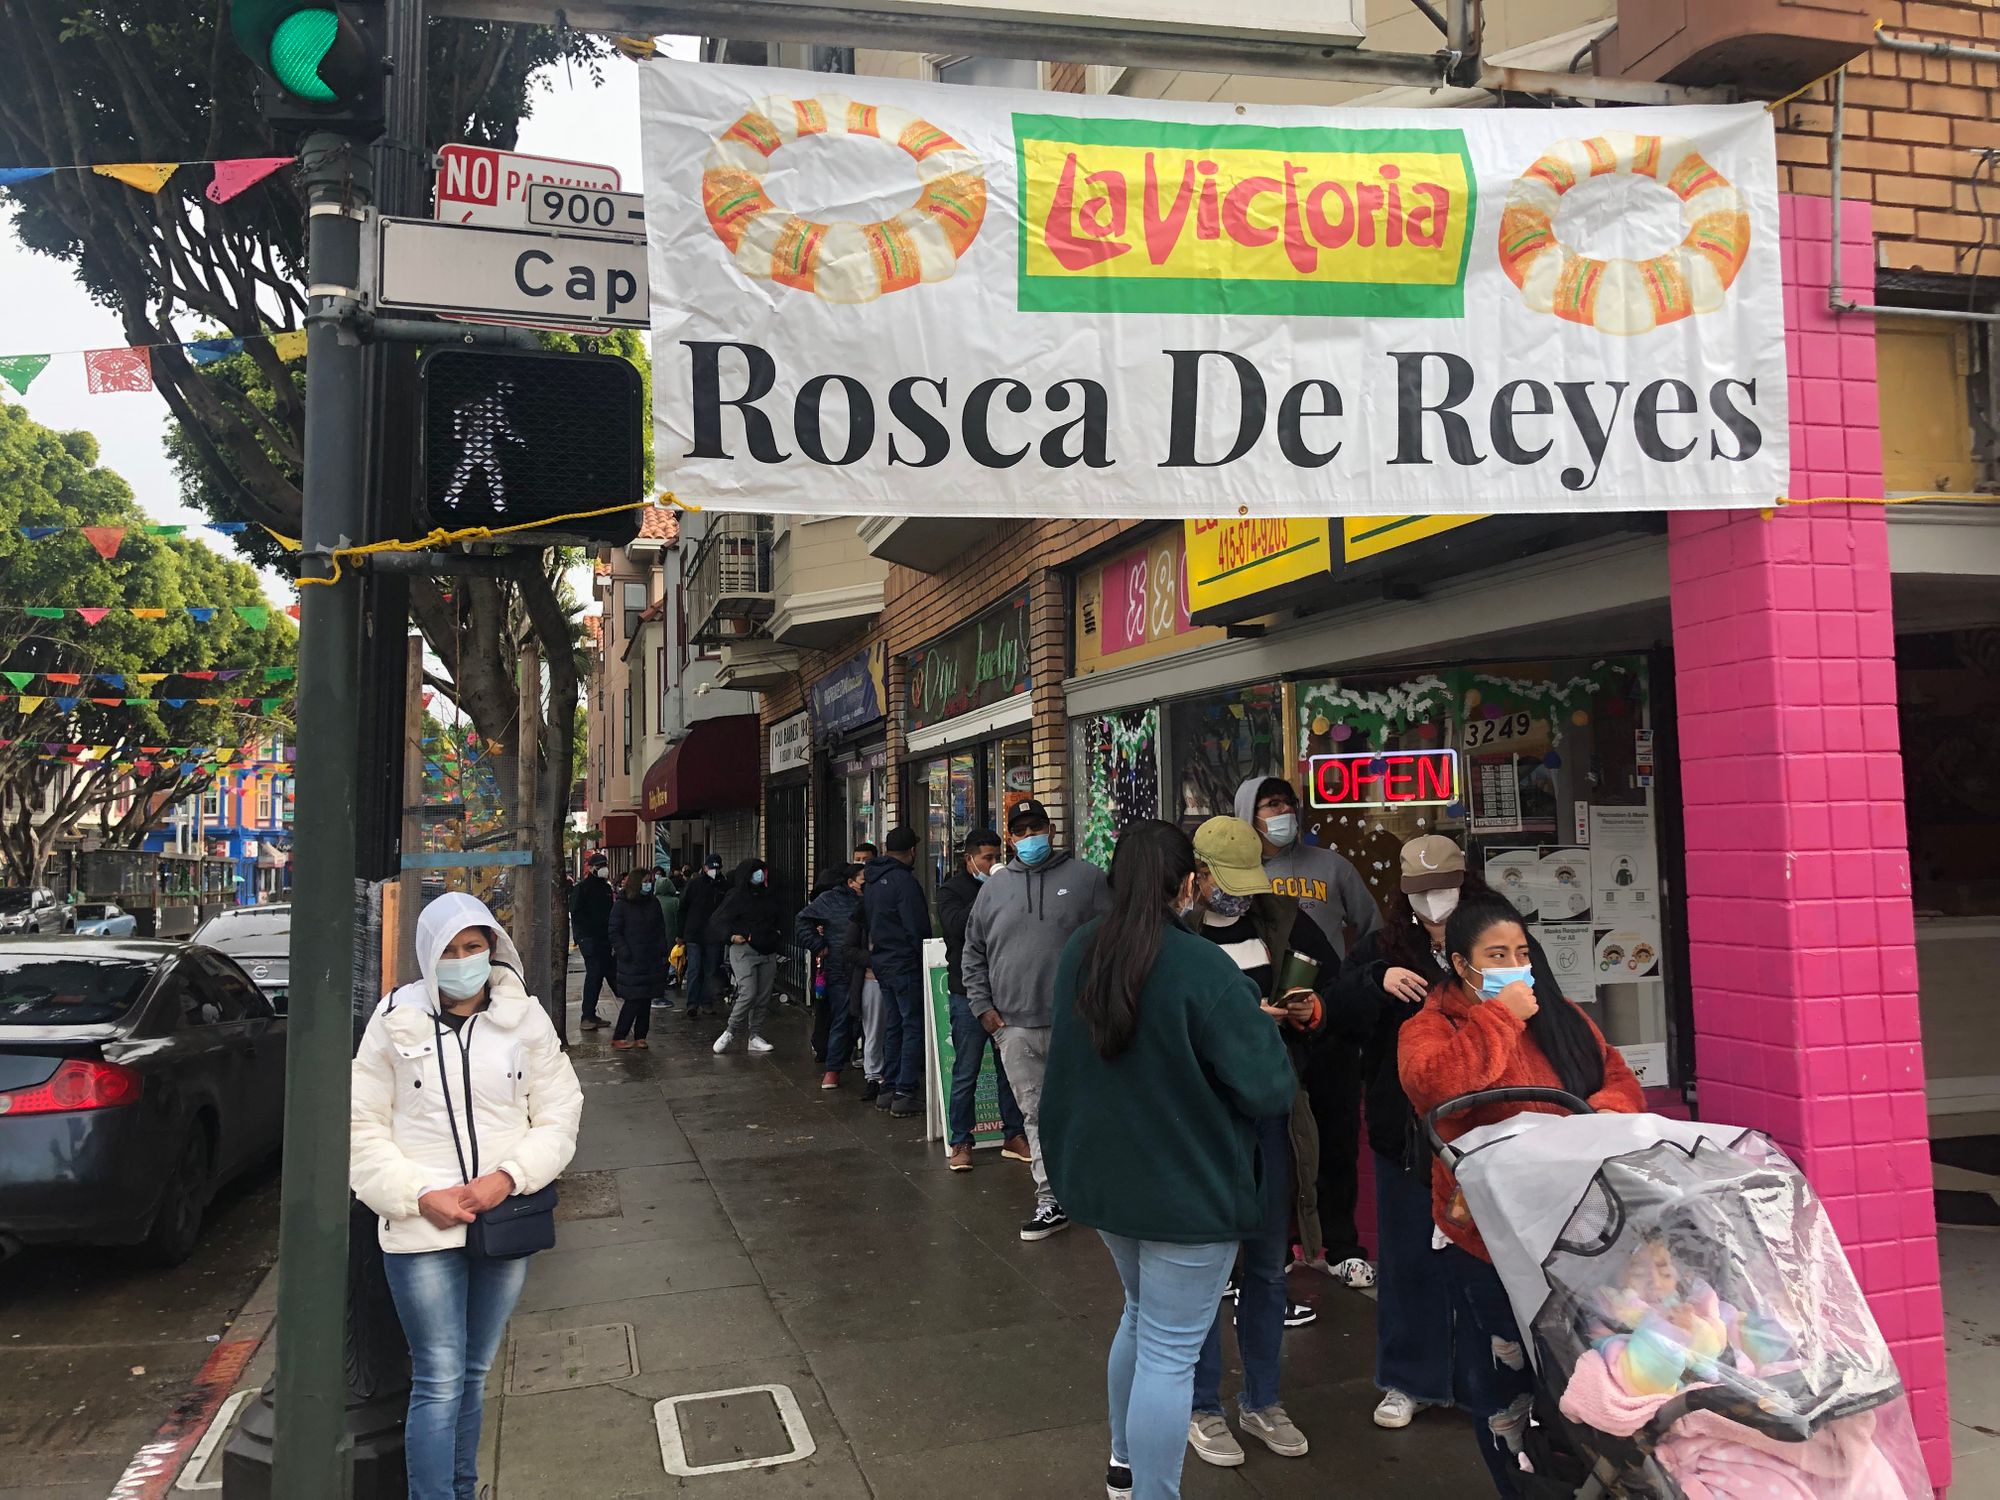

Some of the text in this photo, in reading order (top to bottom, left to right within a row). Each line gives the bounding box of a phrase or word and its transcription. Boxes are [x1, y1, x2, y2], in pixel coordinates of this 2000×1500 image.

[446, 154, 493, 200] NO
[543, 191, 615, 227] 900
[1044, 152, 1450, 273] La Victoria
[514, 249, 638, 315] Cap
[679, 340, 1763, 491] Rosca De Reyes
[1218, 517, 1288, 572] 415-874-9203
[1465, 712, 1530, 747] 3249
[1317, 755, 1450, 803] OPEN
[1272, 876, 1328, 904] COLN
